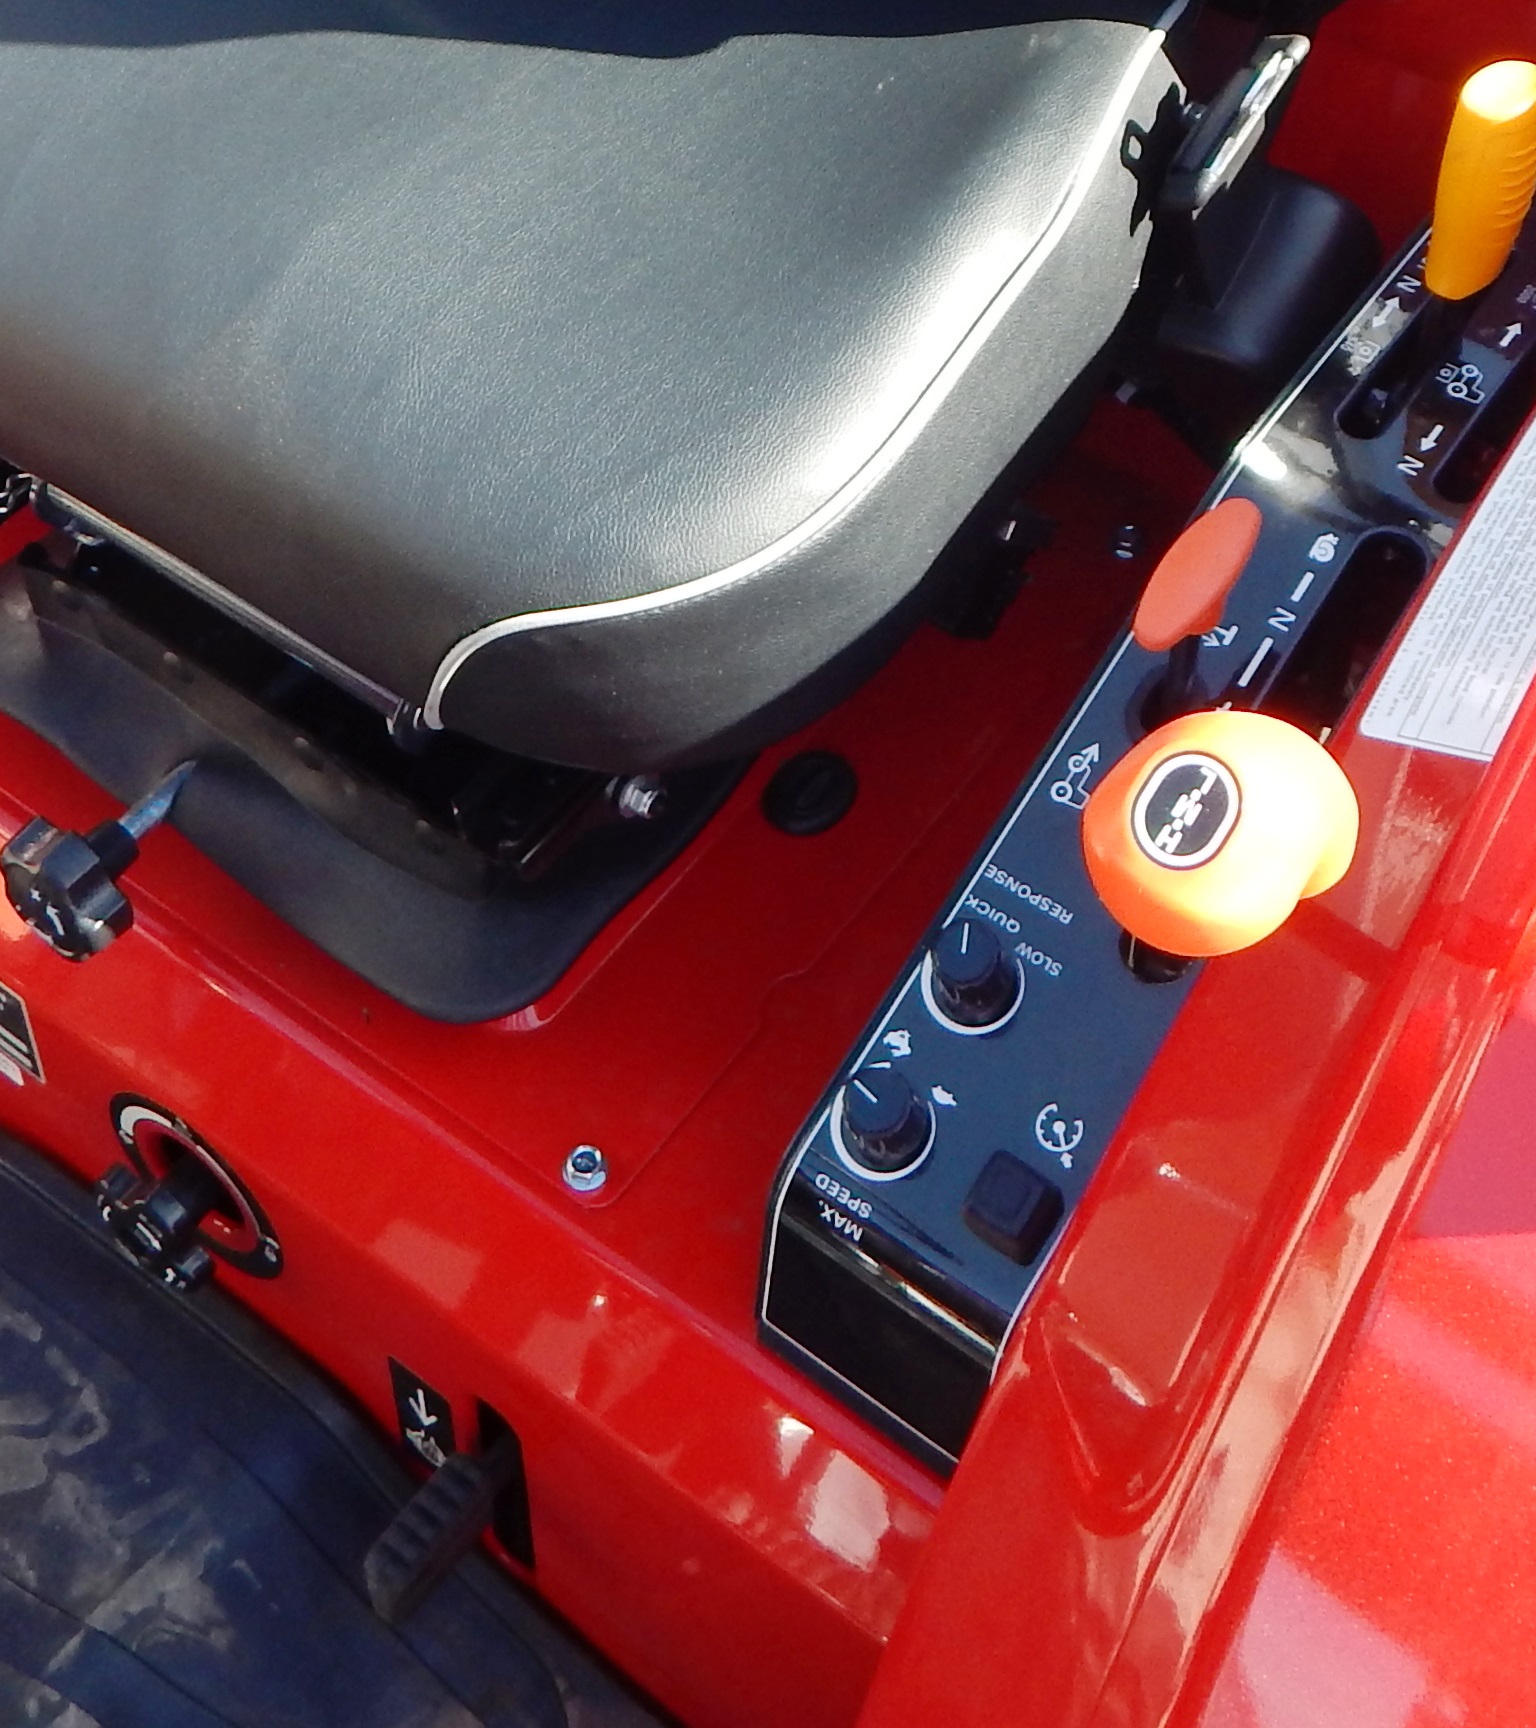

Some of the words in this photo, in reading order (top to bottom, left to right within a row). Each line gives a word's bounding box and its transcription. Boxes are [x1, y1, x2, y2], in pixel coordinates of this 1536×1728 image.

[965, 894, 1021, 933] QUICK
[984, 863, 1074, 925] RESPONSE
[1014, 942, 1063, 976] SLOW
[815, 1173, 873, 1219] SPEED
[818, 1200, 863, 1242] MAX.
